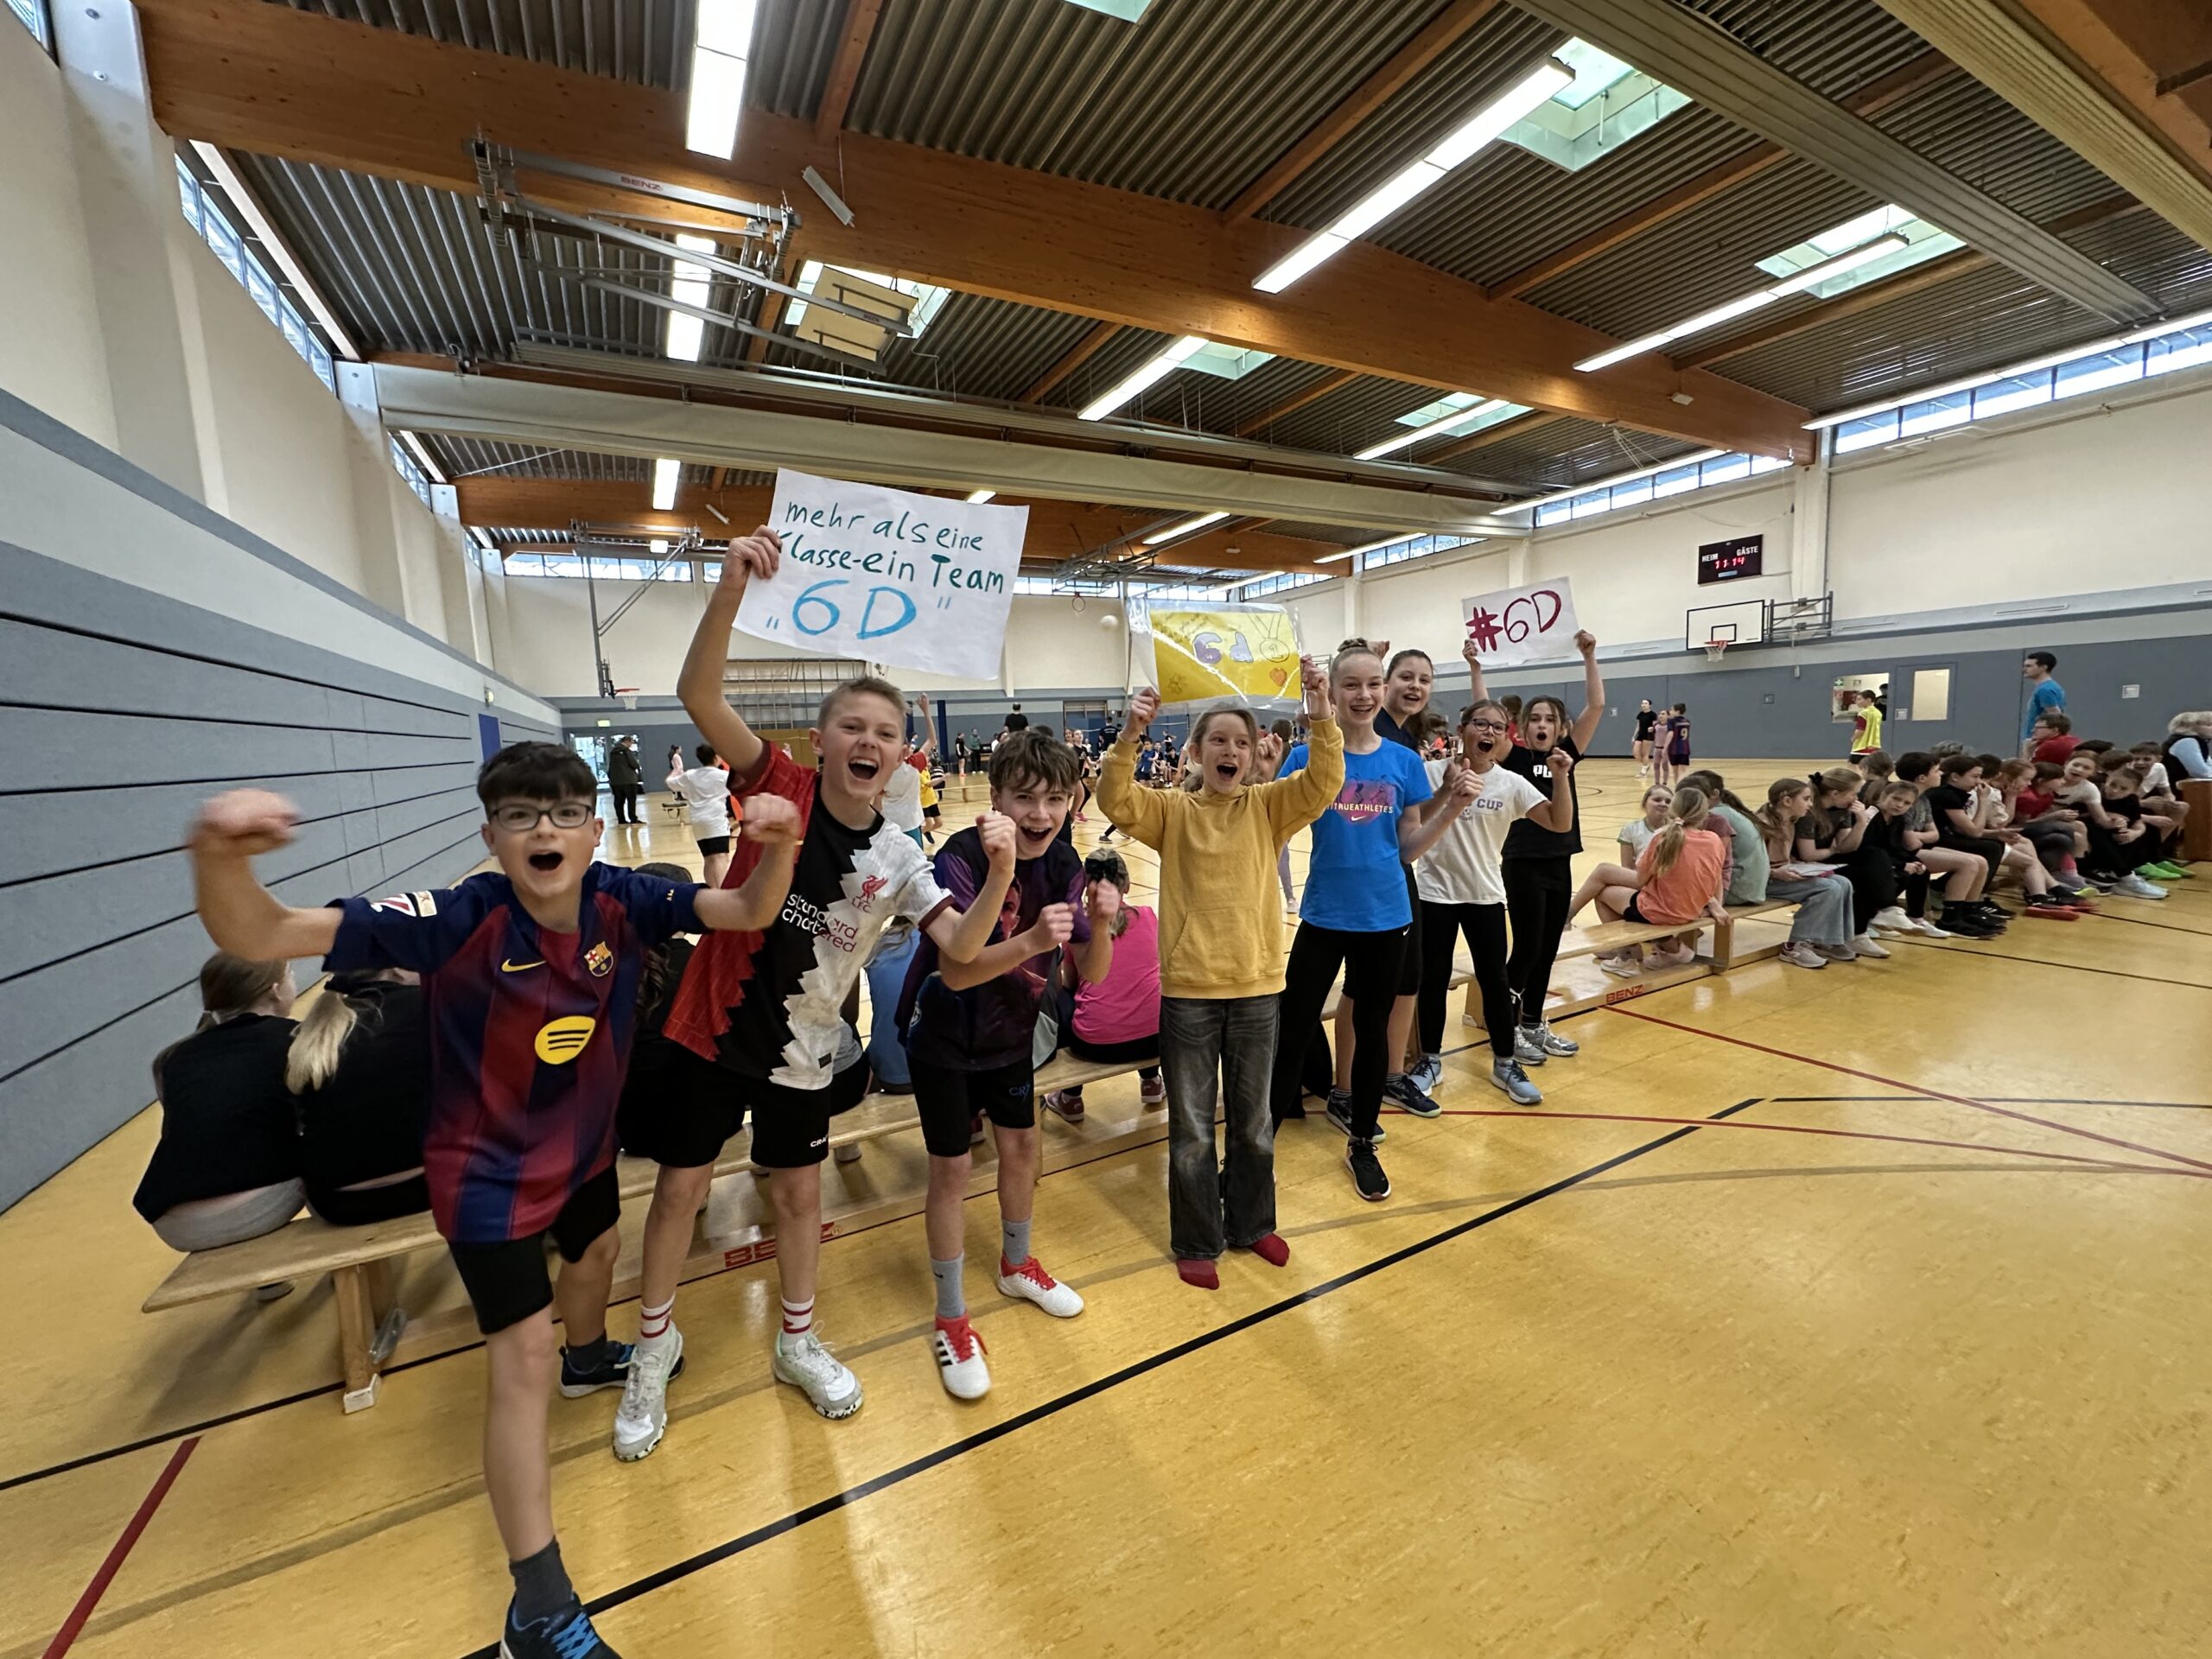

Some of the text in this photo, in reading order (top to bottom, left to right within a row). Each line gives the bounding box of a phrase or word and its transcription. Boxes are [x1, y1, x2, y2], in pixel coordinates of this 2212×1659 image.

[785, 500, 983, 551] mehr als eine
[1701, 546, 1758, 563] HEIM GÄSTE
[930, 553, 1005, 594] Team
[1465, 589, 1562, 652] #6D
[1681, 728, 1688, 741] 9
[1477, 798, 1503, 810] CUP
[851, 898, 872, 913] LFC
[1605, 984, 1644, 1003] BENZ
[724, 1222, 836, 1268] BEZ
